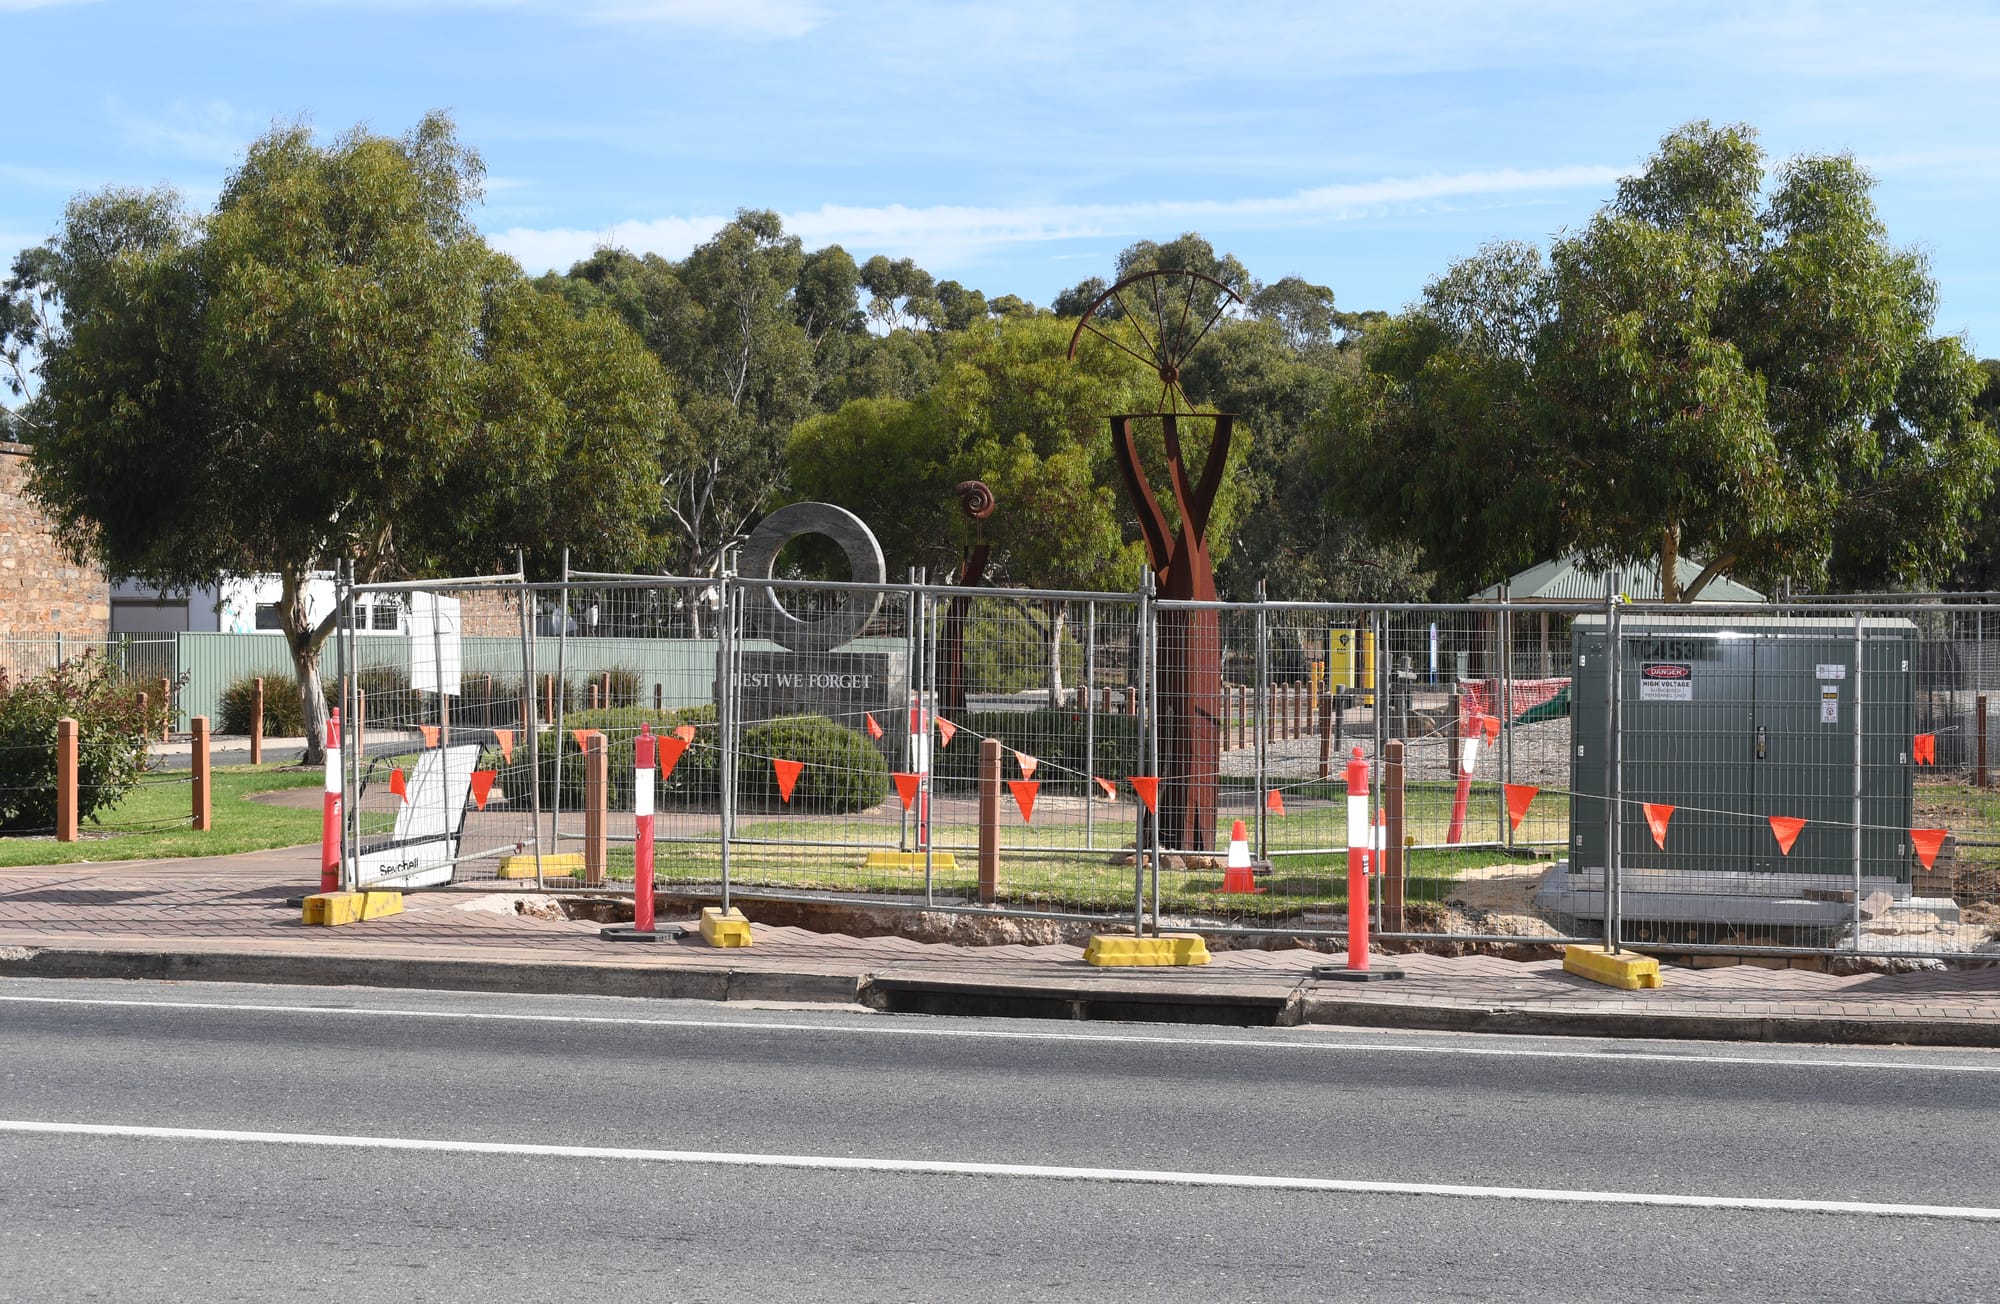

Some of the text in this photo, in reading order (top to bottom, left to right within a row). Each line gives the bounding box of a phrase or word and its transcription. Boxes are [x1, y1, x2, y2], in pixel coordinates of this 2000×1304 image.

[1650, 667, 1682, 675] DANGER
[776, 673, 803, 688] WE
[808, 674, 873, 689] FORGET
